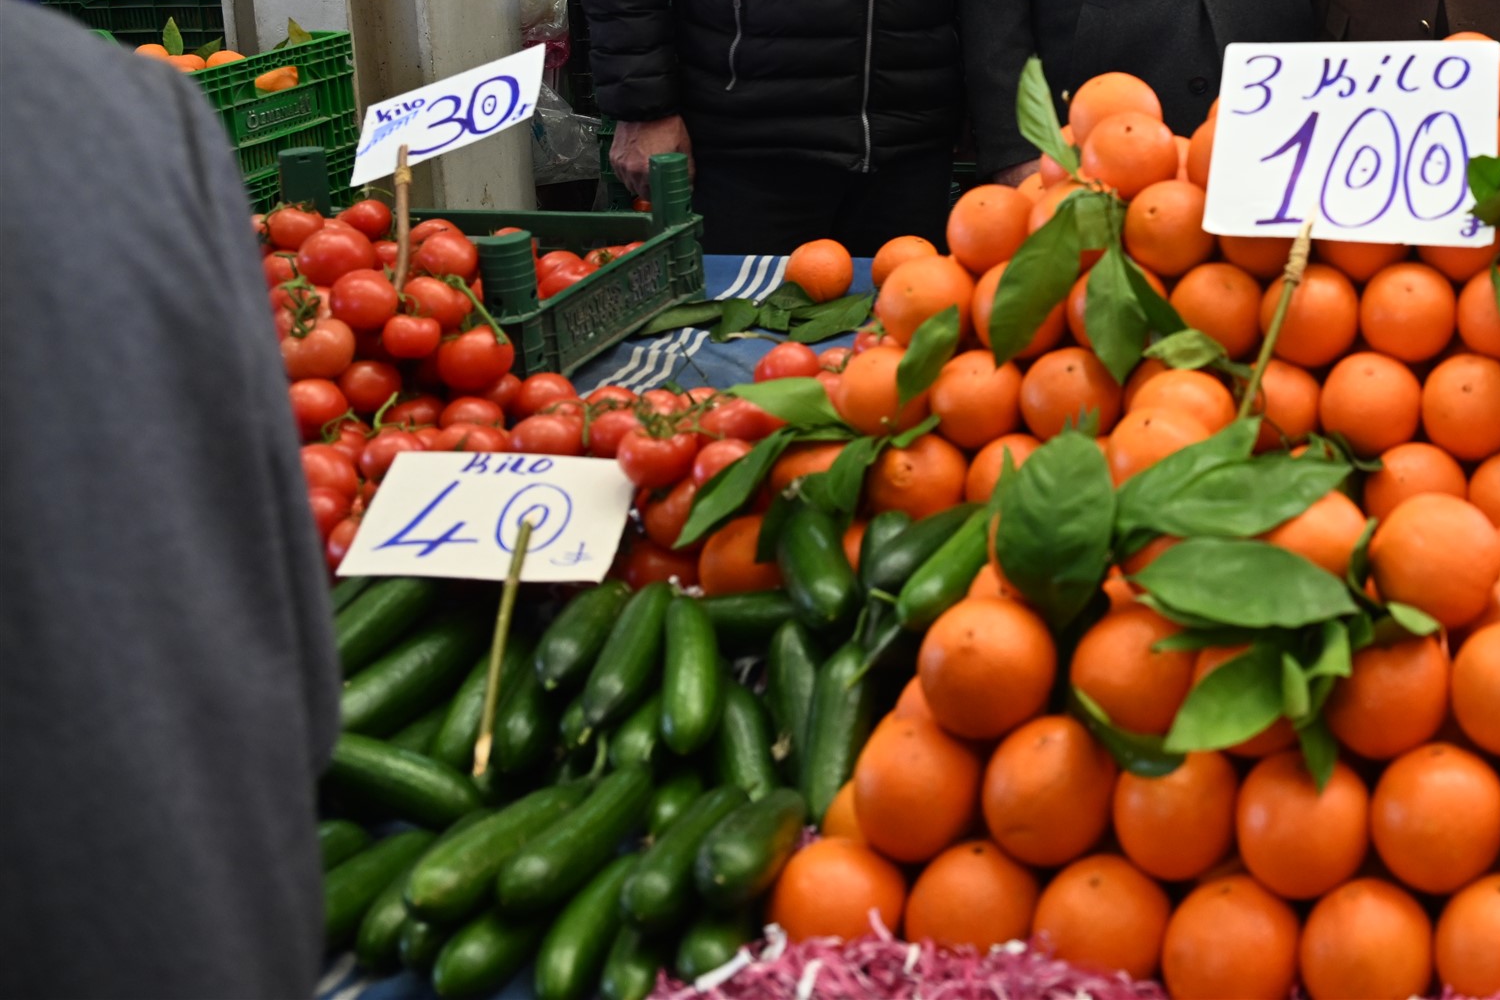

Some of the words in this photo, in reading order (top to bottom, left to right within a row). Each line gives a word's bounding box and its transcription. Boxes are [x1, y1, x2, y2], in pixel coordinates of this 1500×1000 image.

[407, 75, 520, 155] 30
[1231, 55, 1282, 115] 3
[1255, 107, 1469, 228] 100
[371, 480, 573, 558] 40
